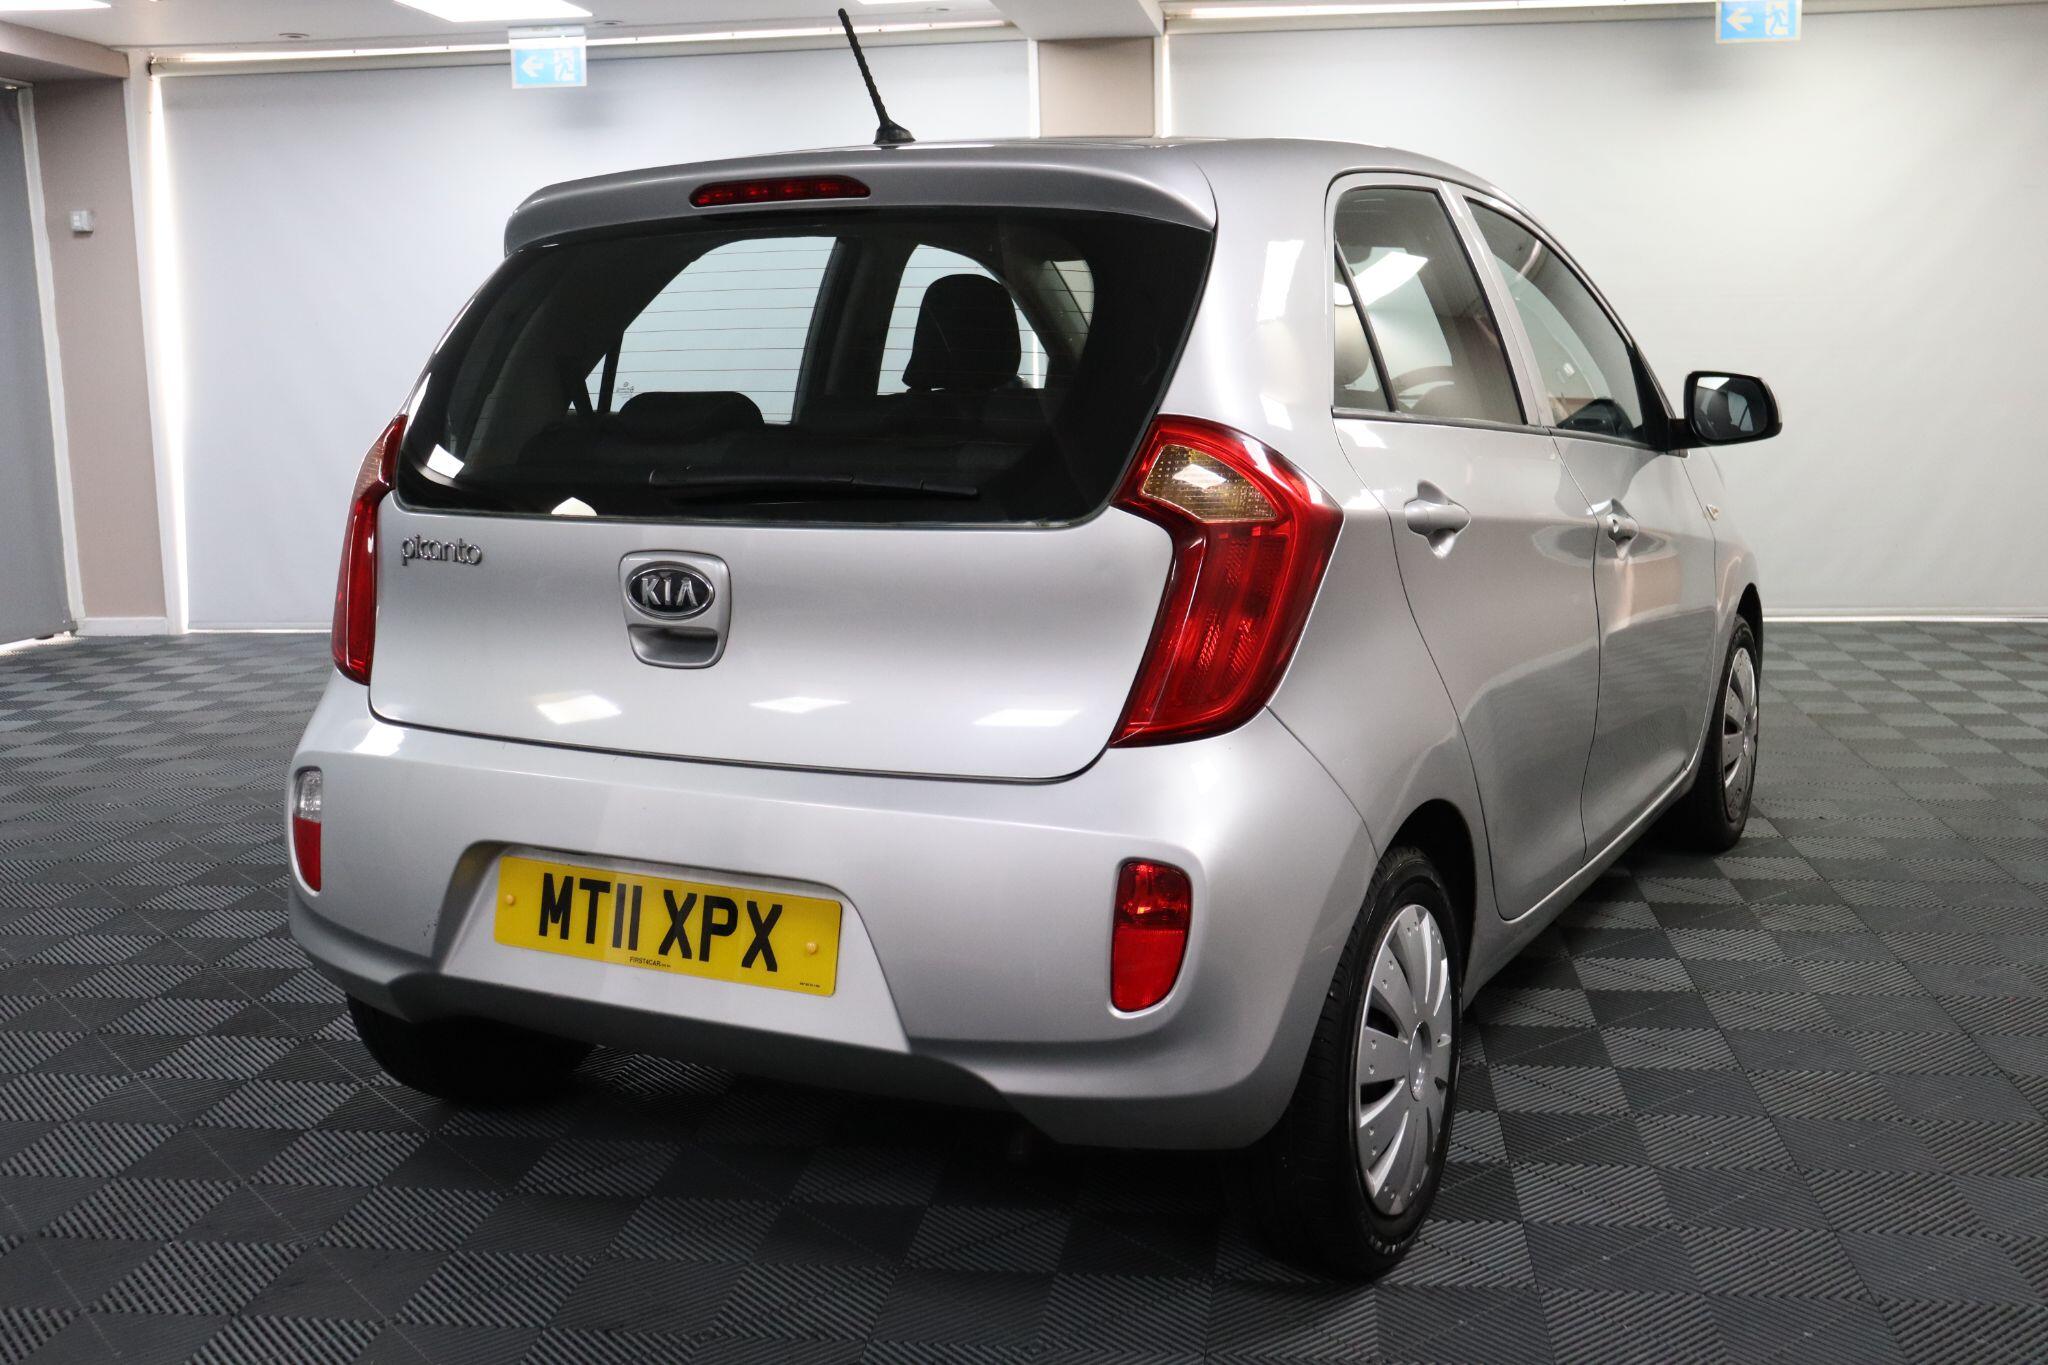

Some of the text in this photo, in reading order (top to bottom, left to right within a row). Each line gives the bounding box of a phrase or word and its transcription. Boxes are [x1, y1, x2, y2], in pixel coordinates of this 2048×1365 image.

[401, 534, 482, 566] picanto
[641, 575, 699, 607] KIA
[538, 873, 783, 972] MT11 XPX
